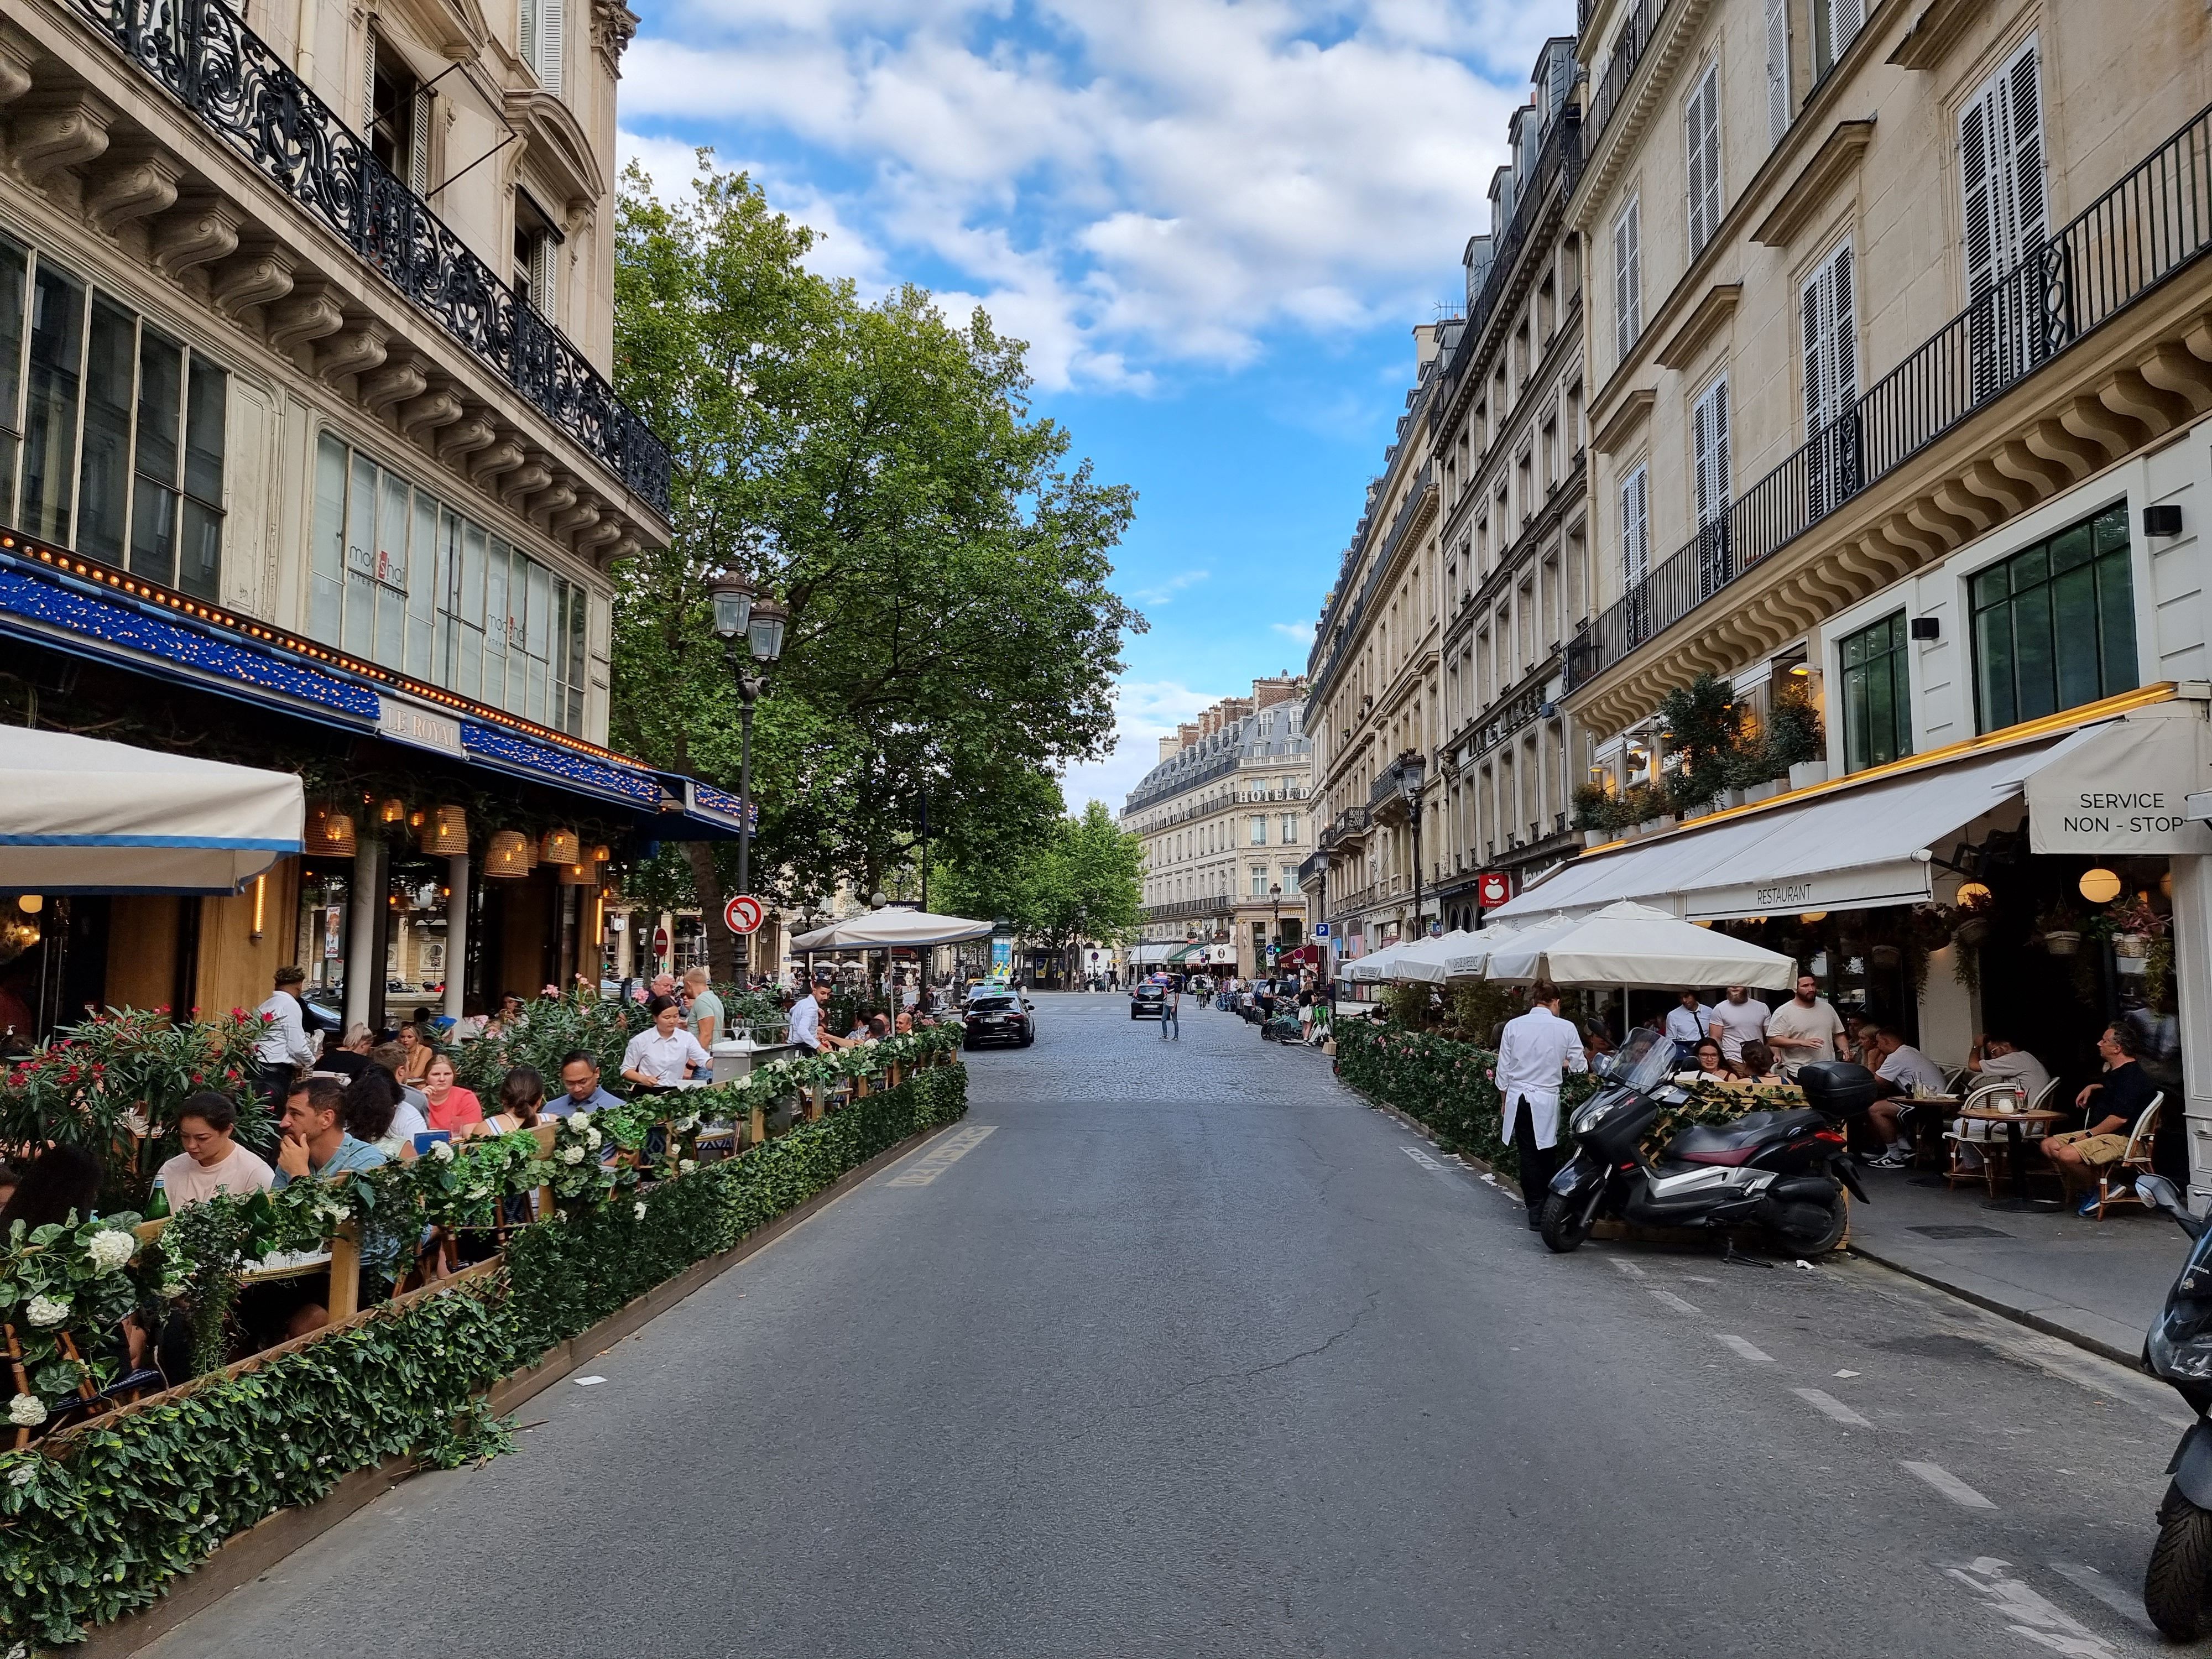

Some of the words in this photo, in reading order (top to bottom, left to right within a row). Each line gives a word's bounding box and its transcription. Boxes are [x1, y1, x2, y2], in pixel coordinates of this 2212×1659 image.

[387, 707, 406, 733] LE
[413, 715, 458, 749] ROYAL
[1239, 790, 1294, 803] HOTEL
[2080, 793, 2164, 808] SERVICE
[1152, 818, 1166, 831] HOTEL
[1166, 815, 1172, 826] DU
[1172, 809, 1190, 824] LOUVRE
[2063, 817, 2109, 832] NON
[2129, 817, 2184, 832] STOP
[1757, 884, 1811, 905] RESTAURANT
[1319, 926, 1326, 935] P
